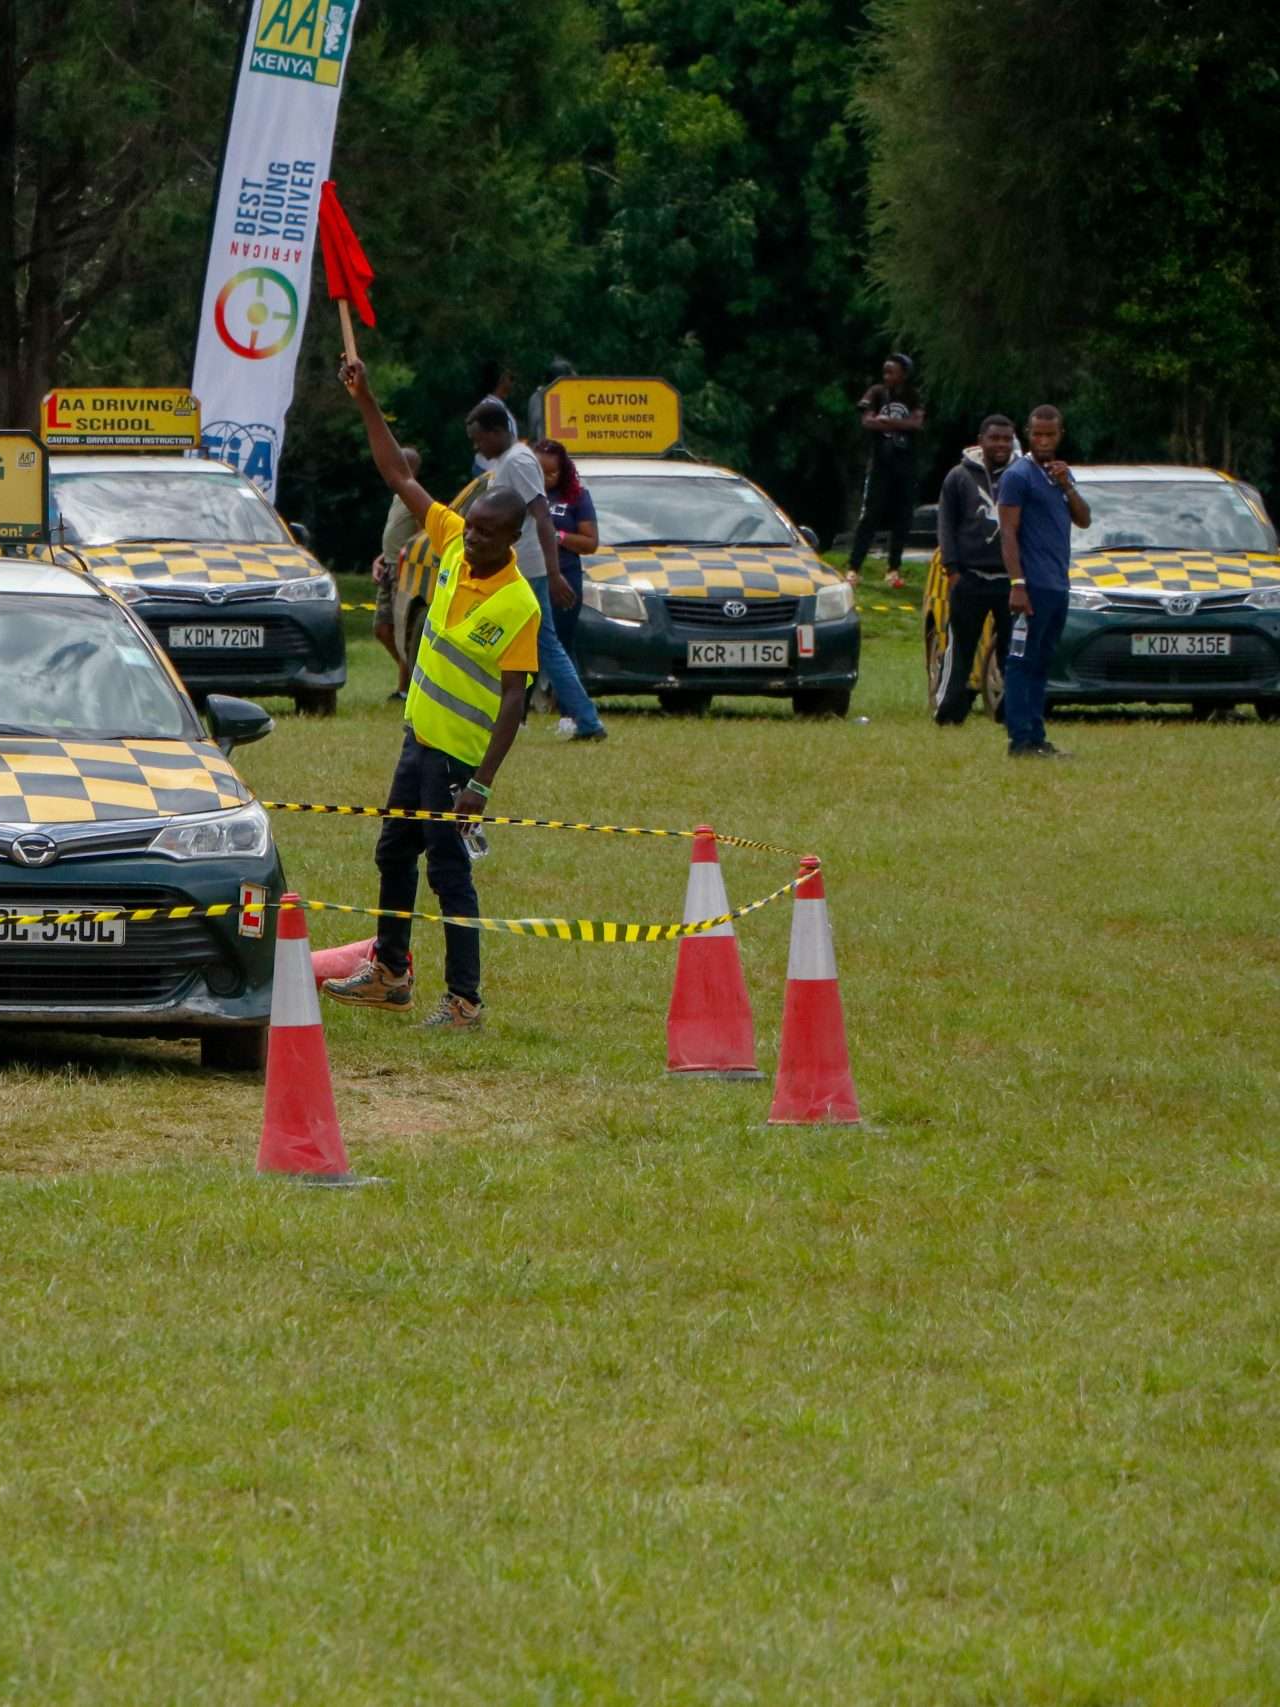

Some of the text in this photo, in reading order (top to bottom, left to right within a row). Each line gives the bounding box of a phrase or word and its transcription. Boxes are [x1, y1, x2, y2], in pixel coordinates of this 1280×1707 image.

[260, 0, 319, 49] AA
[252, 52, 313, 76] KENYA
[235, 178, 263, 236] BEST
[258, 162, 290, 237] YOUNG
[282, 160, 316, 242] DRIVER
[230, 240, 302, 263] AFRICAN
[47, 393, 72, 429] L
[58, 399, 173, 412] AA DRIVING
[587, 394, 648, 405] CAUTION
[76, 418, 155, 431] SCHOOL
[550, 394, 578, 439] L
[584, 414, 655, 423] DRIVER UNDER
[86, 436, 114, 444] DRIVER
[143, 437, 193, 445] INSTRUCTION
[587, 430, 652, 439] INSTRUCTION
[184, 629, 259, 646] KDM 720N
[798, 629, 815, 653] L
[1148, 637, 1226, 654] KDX 315E
[692, 645, 785, 663] KCR 115C
[243, 891, 260, 927] L
